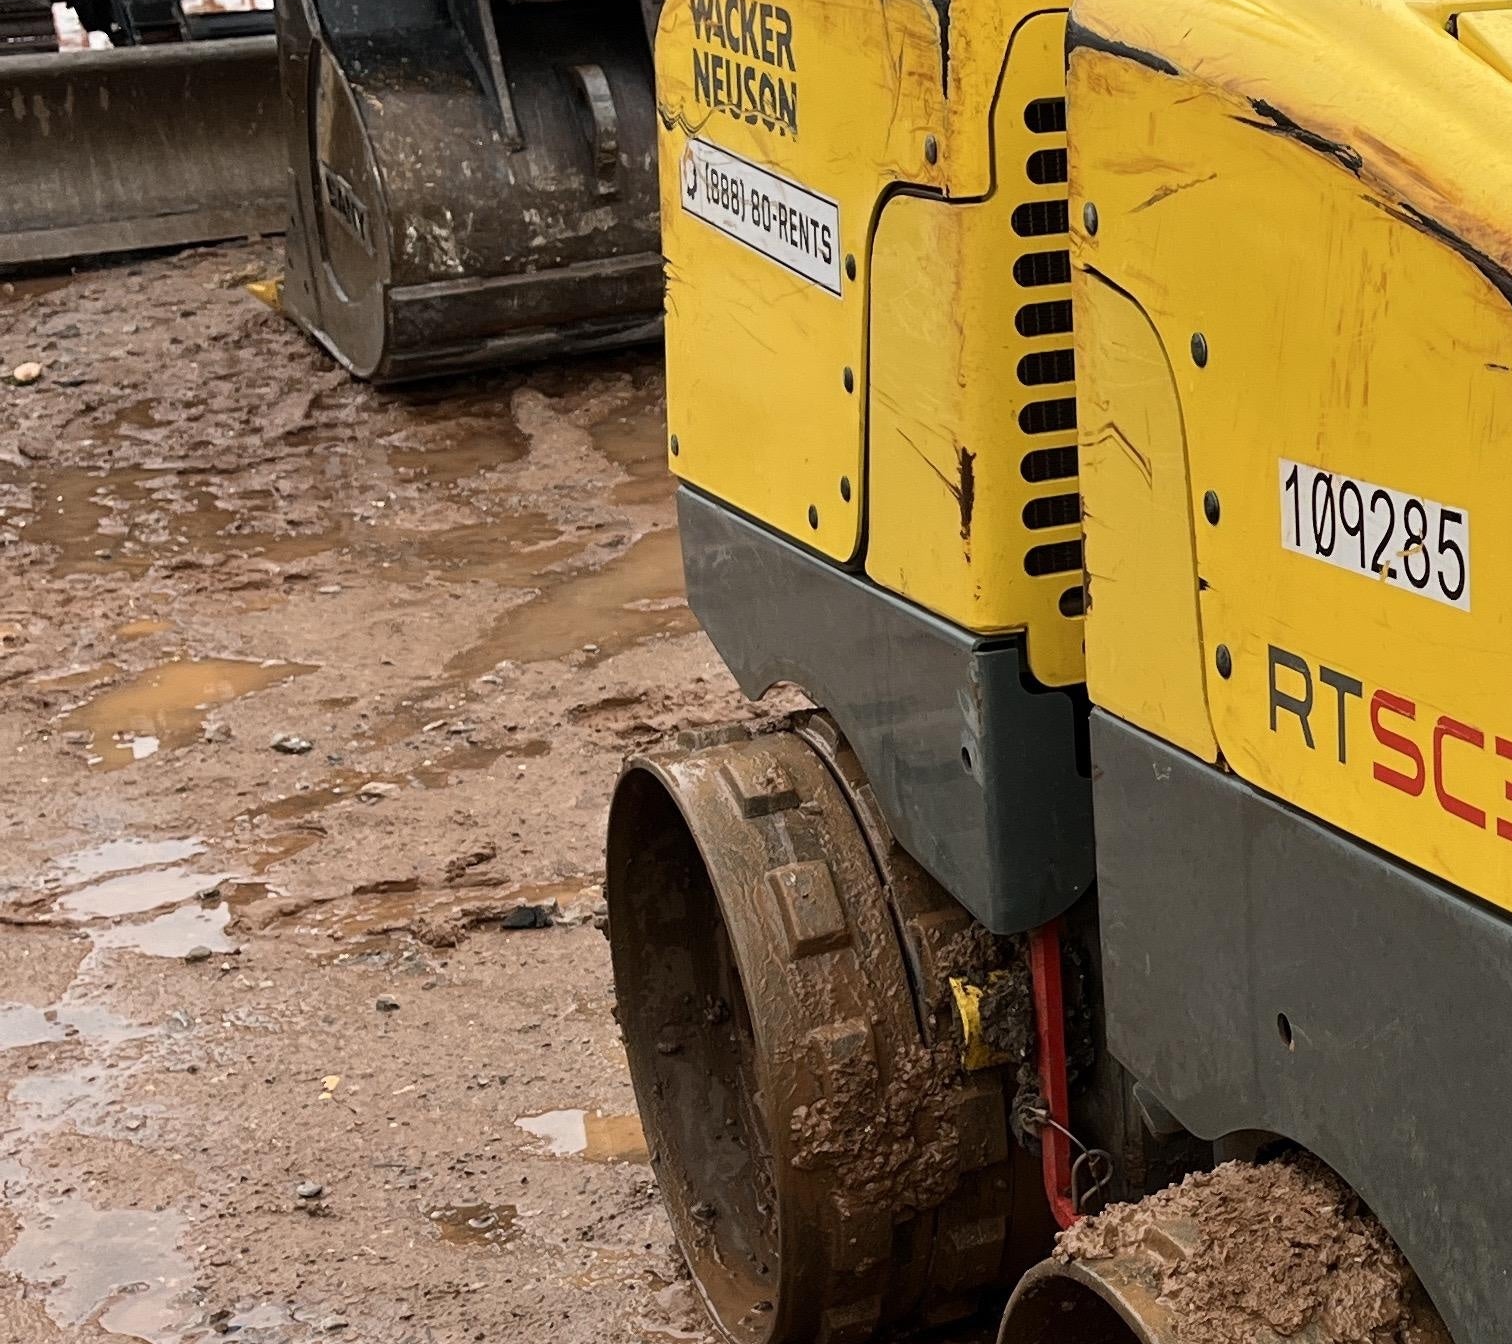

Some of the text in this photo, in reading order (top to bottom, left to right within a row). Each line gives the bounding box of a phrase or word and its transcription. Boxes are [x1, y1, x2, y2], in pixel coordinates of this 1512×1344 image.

[691, 47, 798, 142] NEUSON
[705, 161, 833, 267] (888) 80-RENTS
[1285, 464, 1466, 601] 109285
